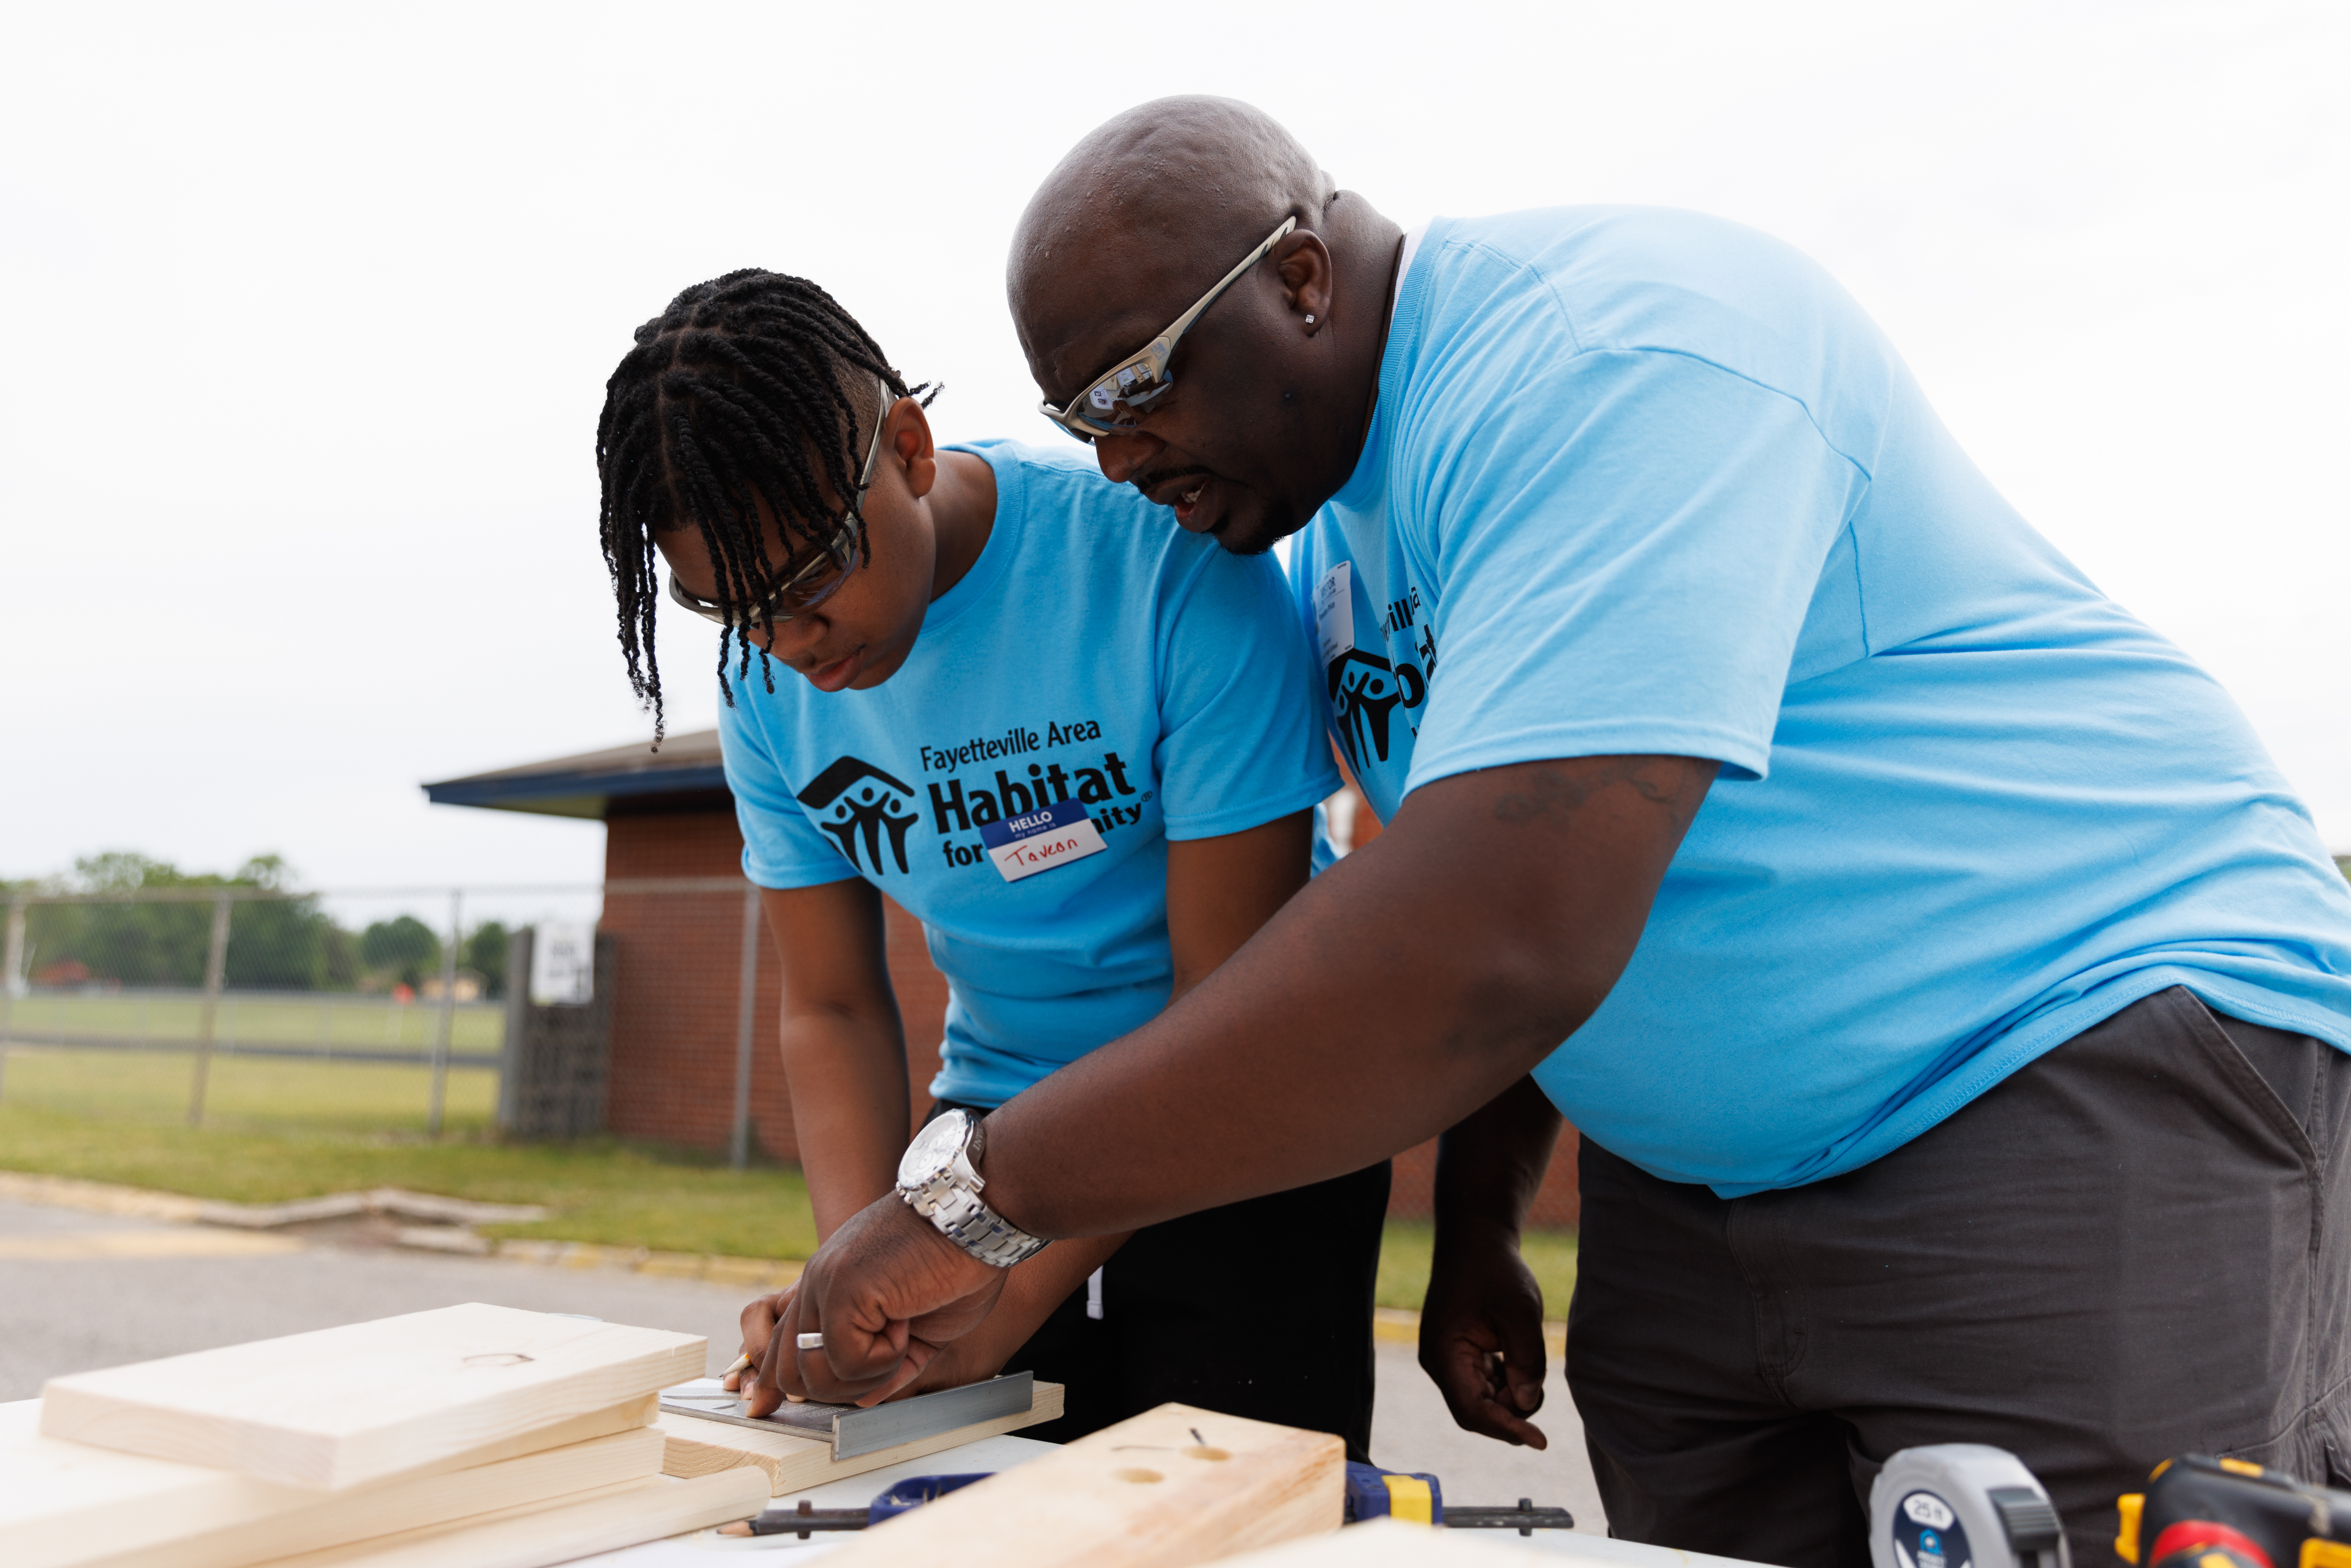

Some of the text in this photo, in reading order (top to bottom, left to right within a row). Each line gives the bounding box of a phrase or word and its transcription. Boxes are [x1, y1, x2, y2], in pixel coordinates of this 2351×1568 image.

[920, 720, 1101, 773] Fayetteville Area
[927, 752, 1137, 835] Habitat
[1009, 810, 1053, 833] HELLO
[1027, 825, 1047, 835] name
[943, 840, 983, 867] for
